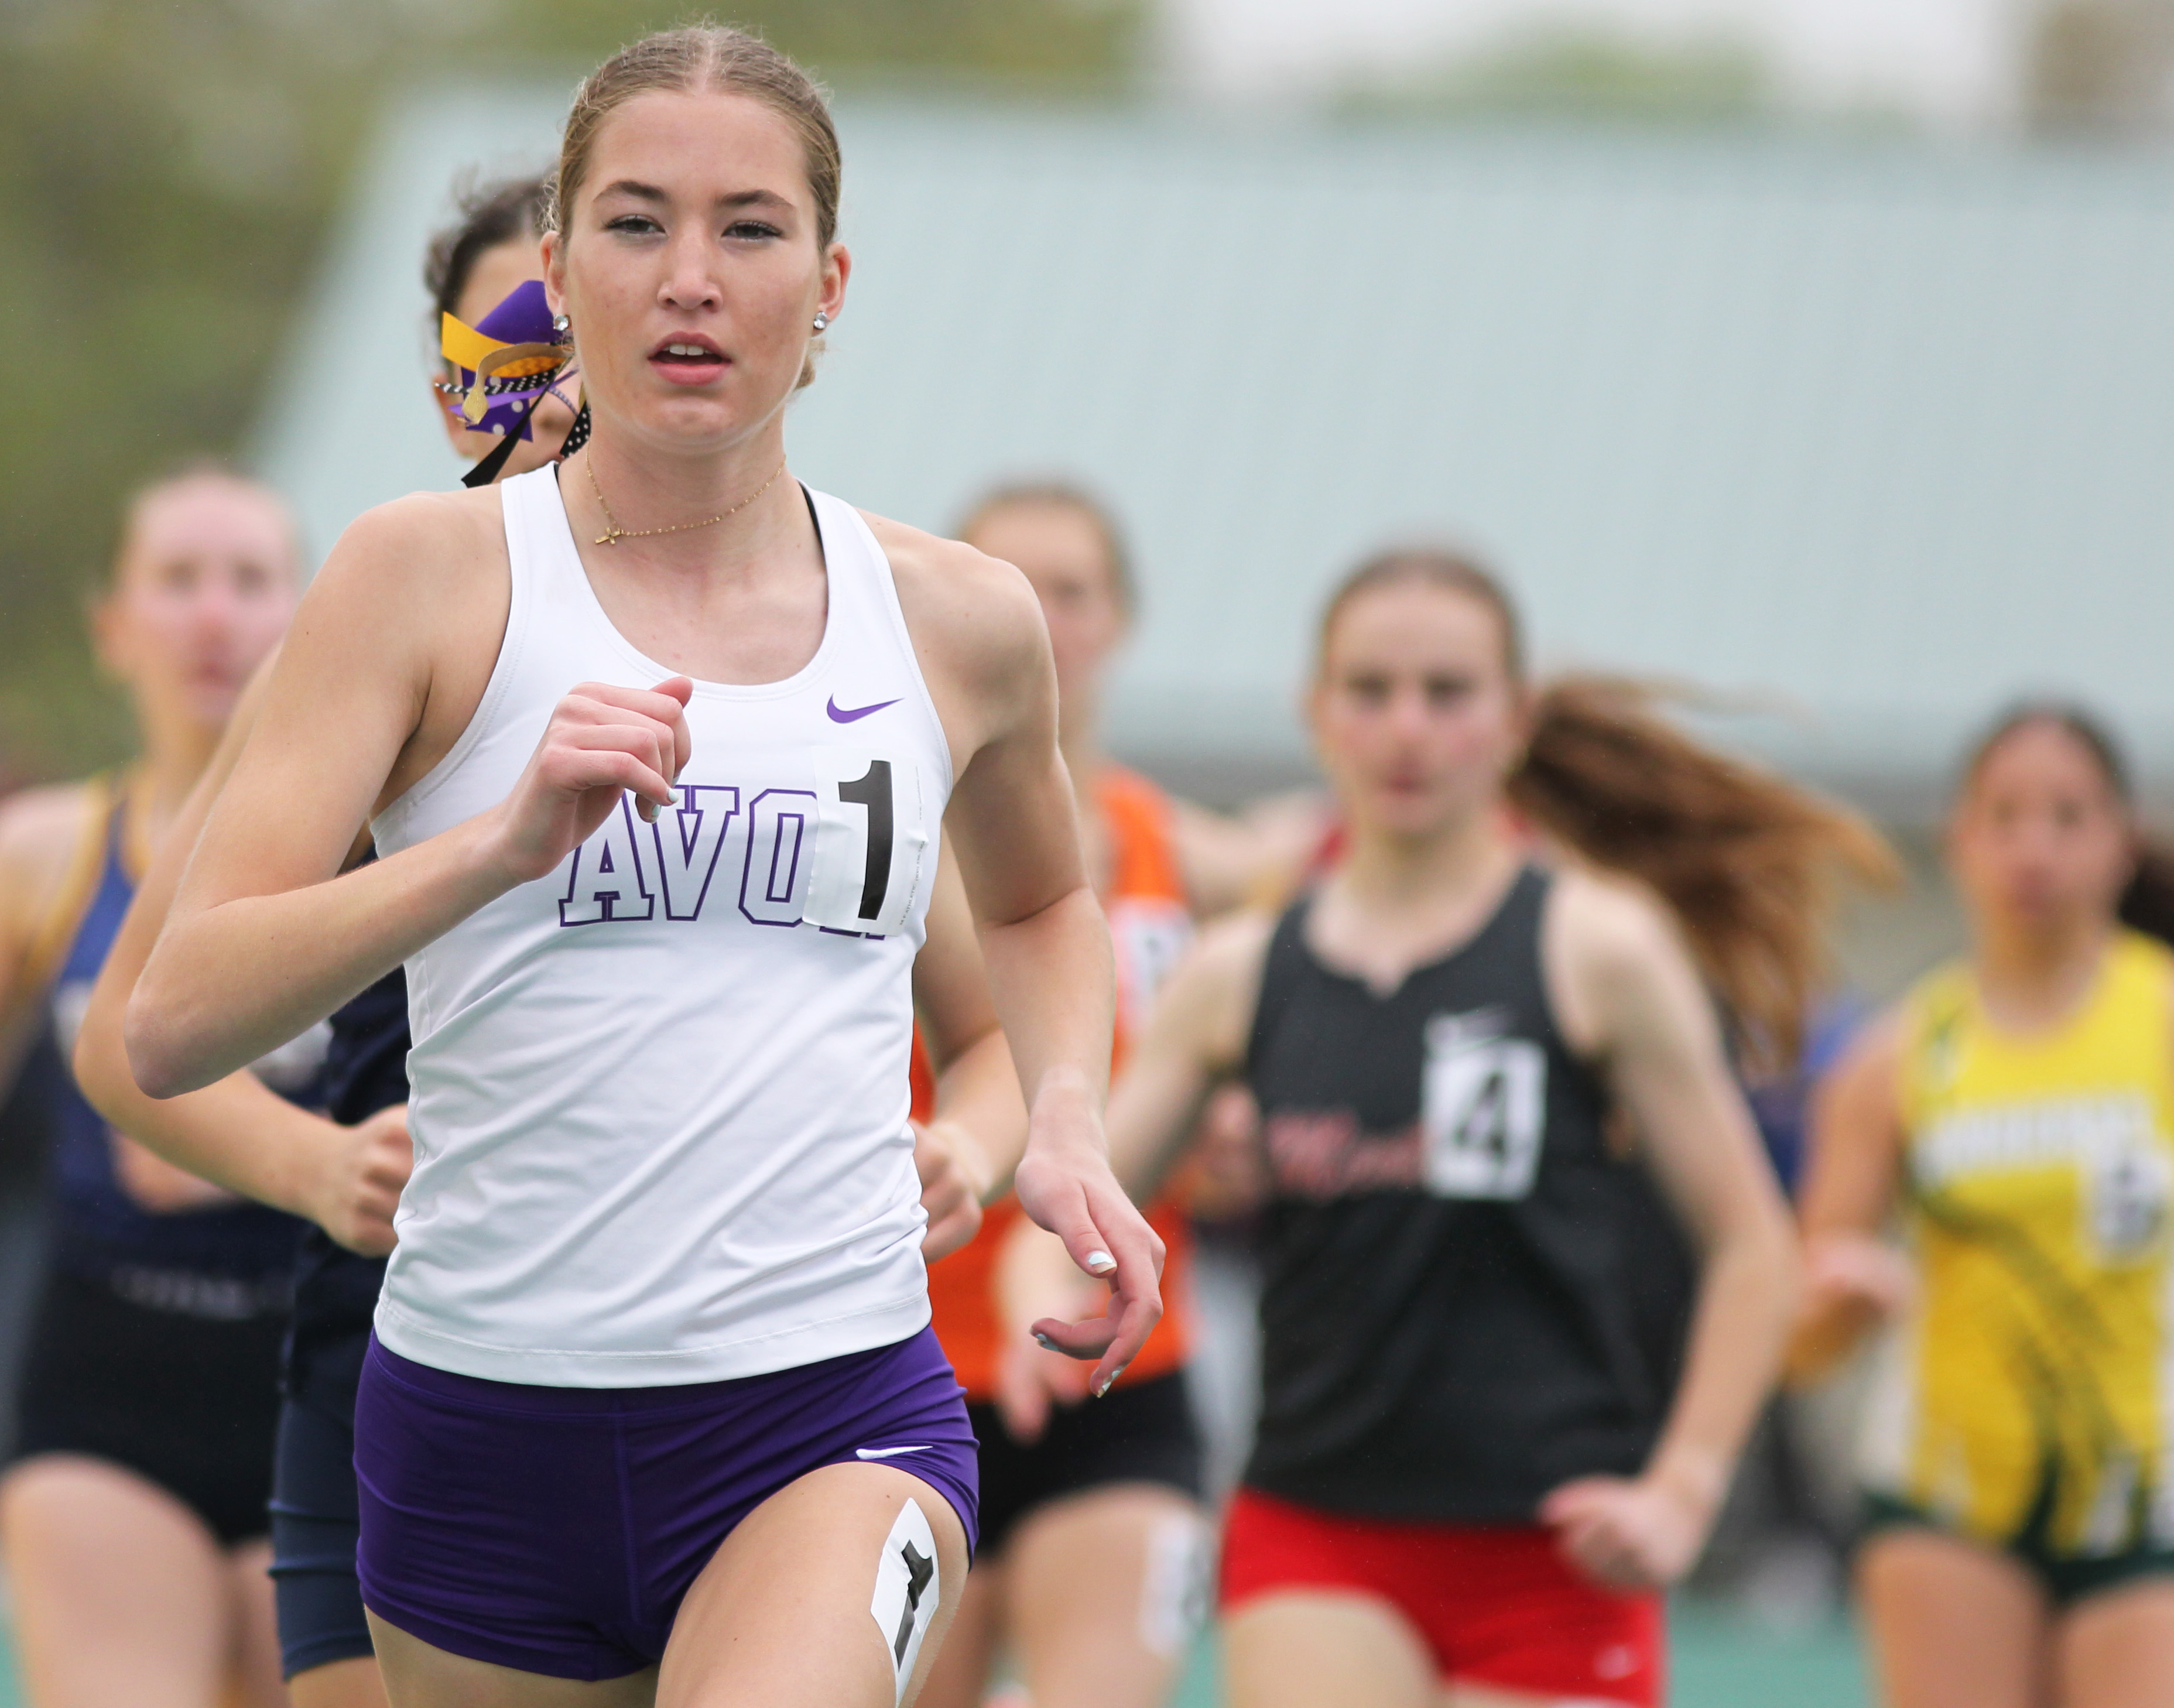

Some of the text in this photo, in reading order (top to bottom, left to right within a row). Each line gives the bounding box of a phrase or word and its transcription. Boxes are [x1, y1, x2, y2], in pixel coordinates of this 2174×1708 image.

[558, 783, 886, 941] AVO
[837, 759, 894, 920] 1
[1450, 1068, 1509, 1171] 4
[894, 1539, 934, 1673] 1
